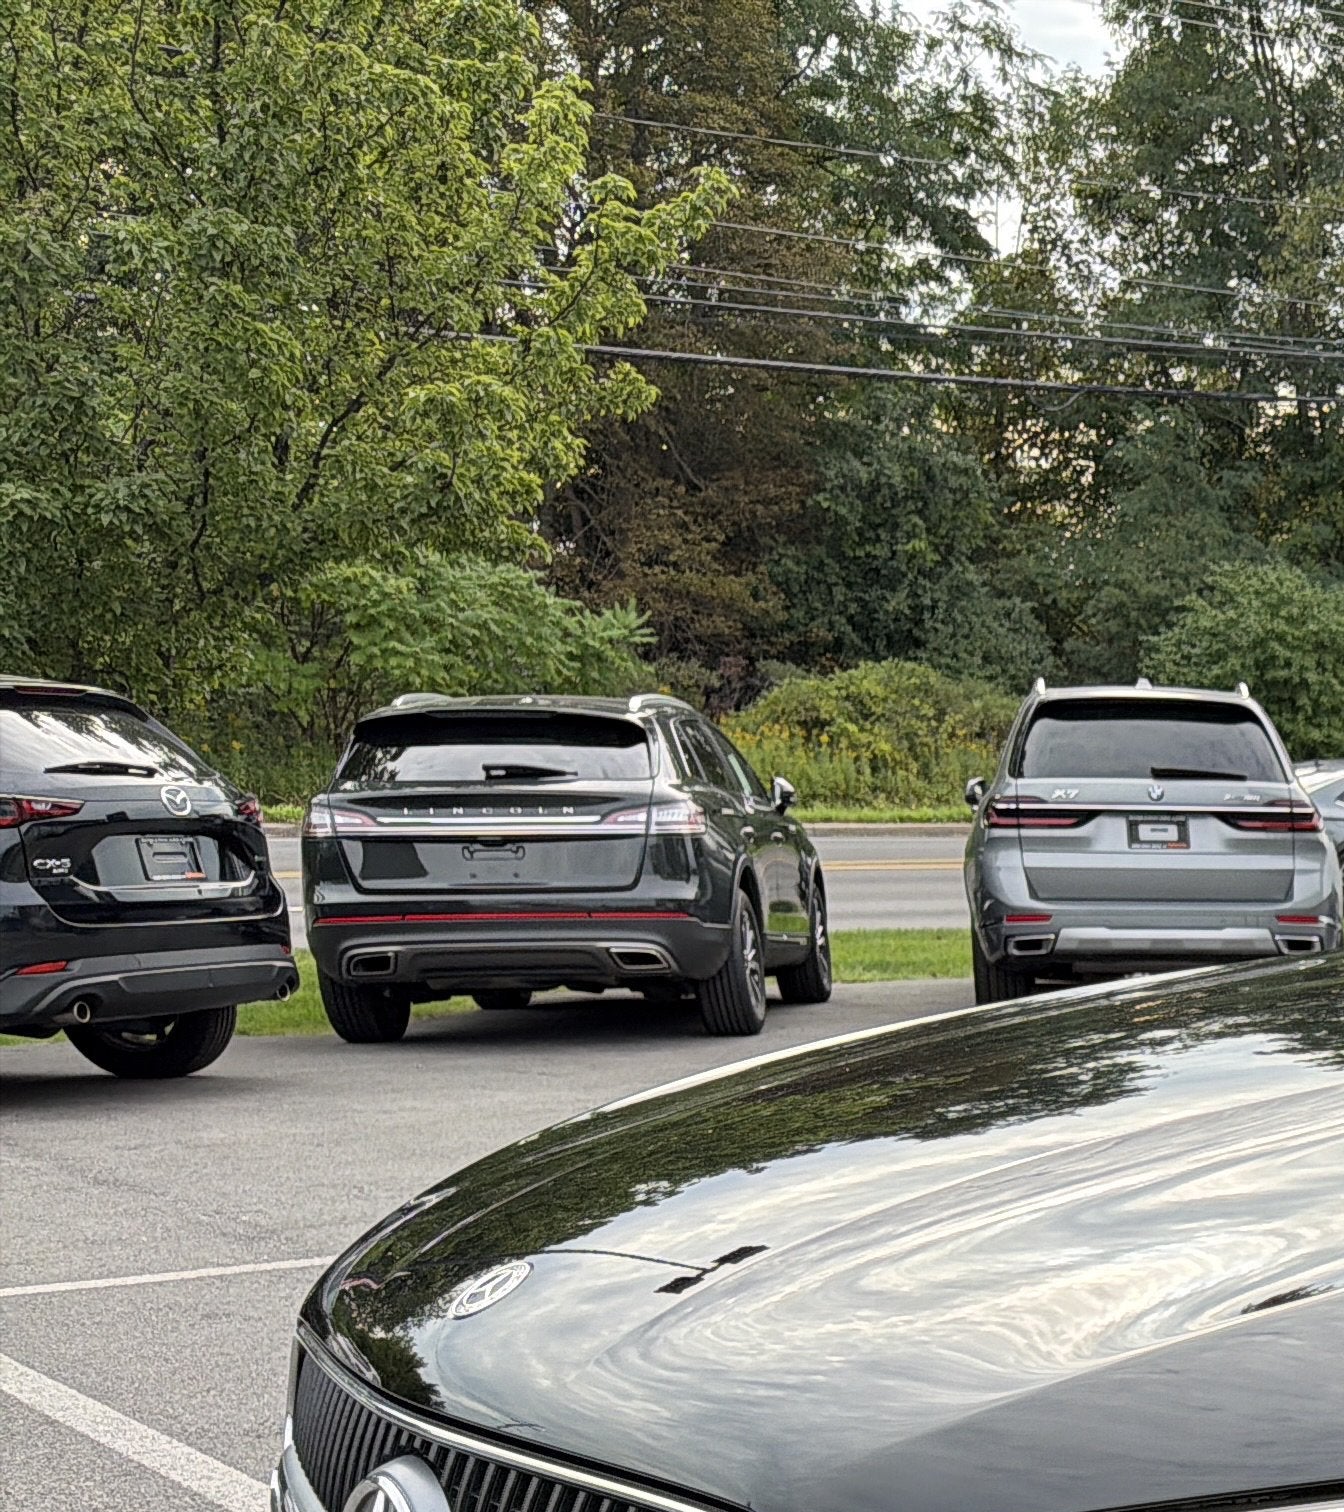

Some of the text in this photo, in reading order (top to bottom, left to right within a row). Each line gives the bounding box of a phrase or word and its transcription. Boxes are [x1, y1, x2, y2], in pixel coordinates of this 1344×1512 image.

[1051, 788, 1081, 800] X7
[402, 806, 575, 816] LINCOLN
[33, 858, 71, 870] CX-5
